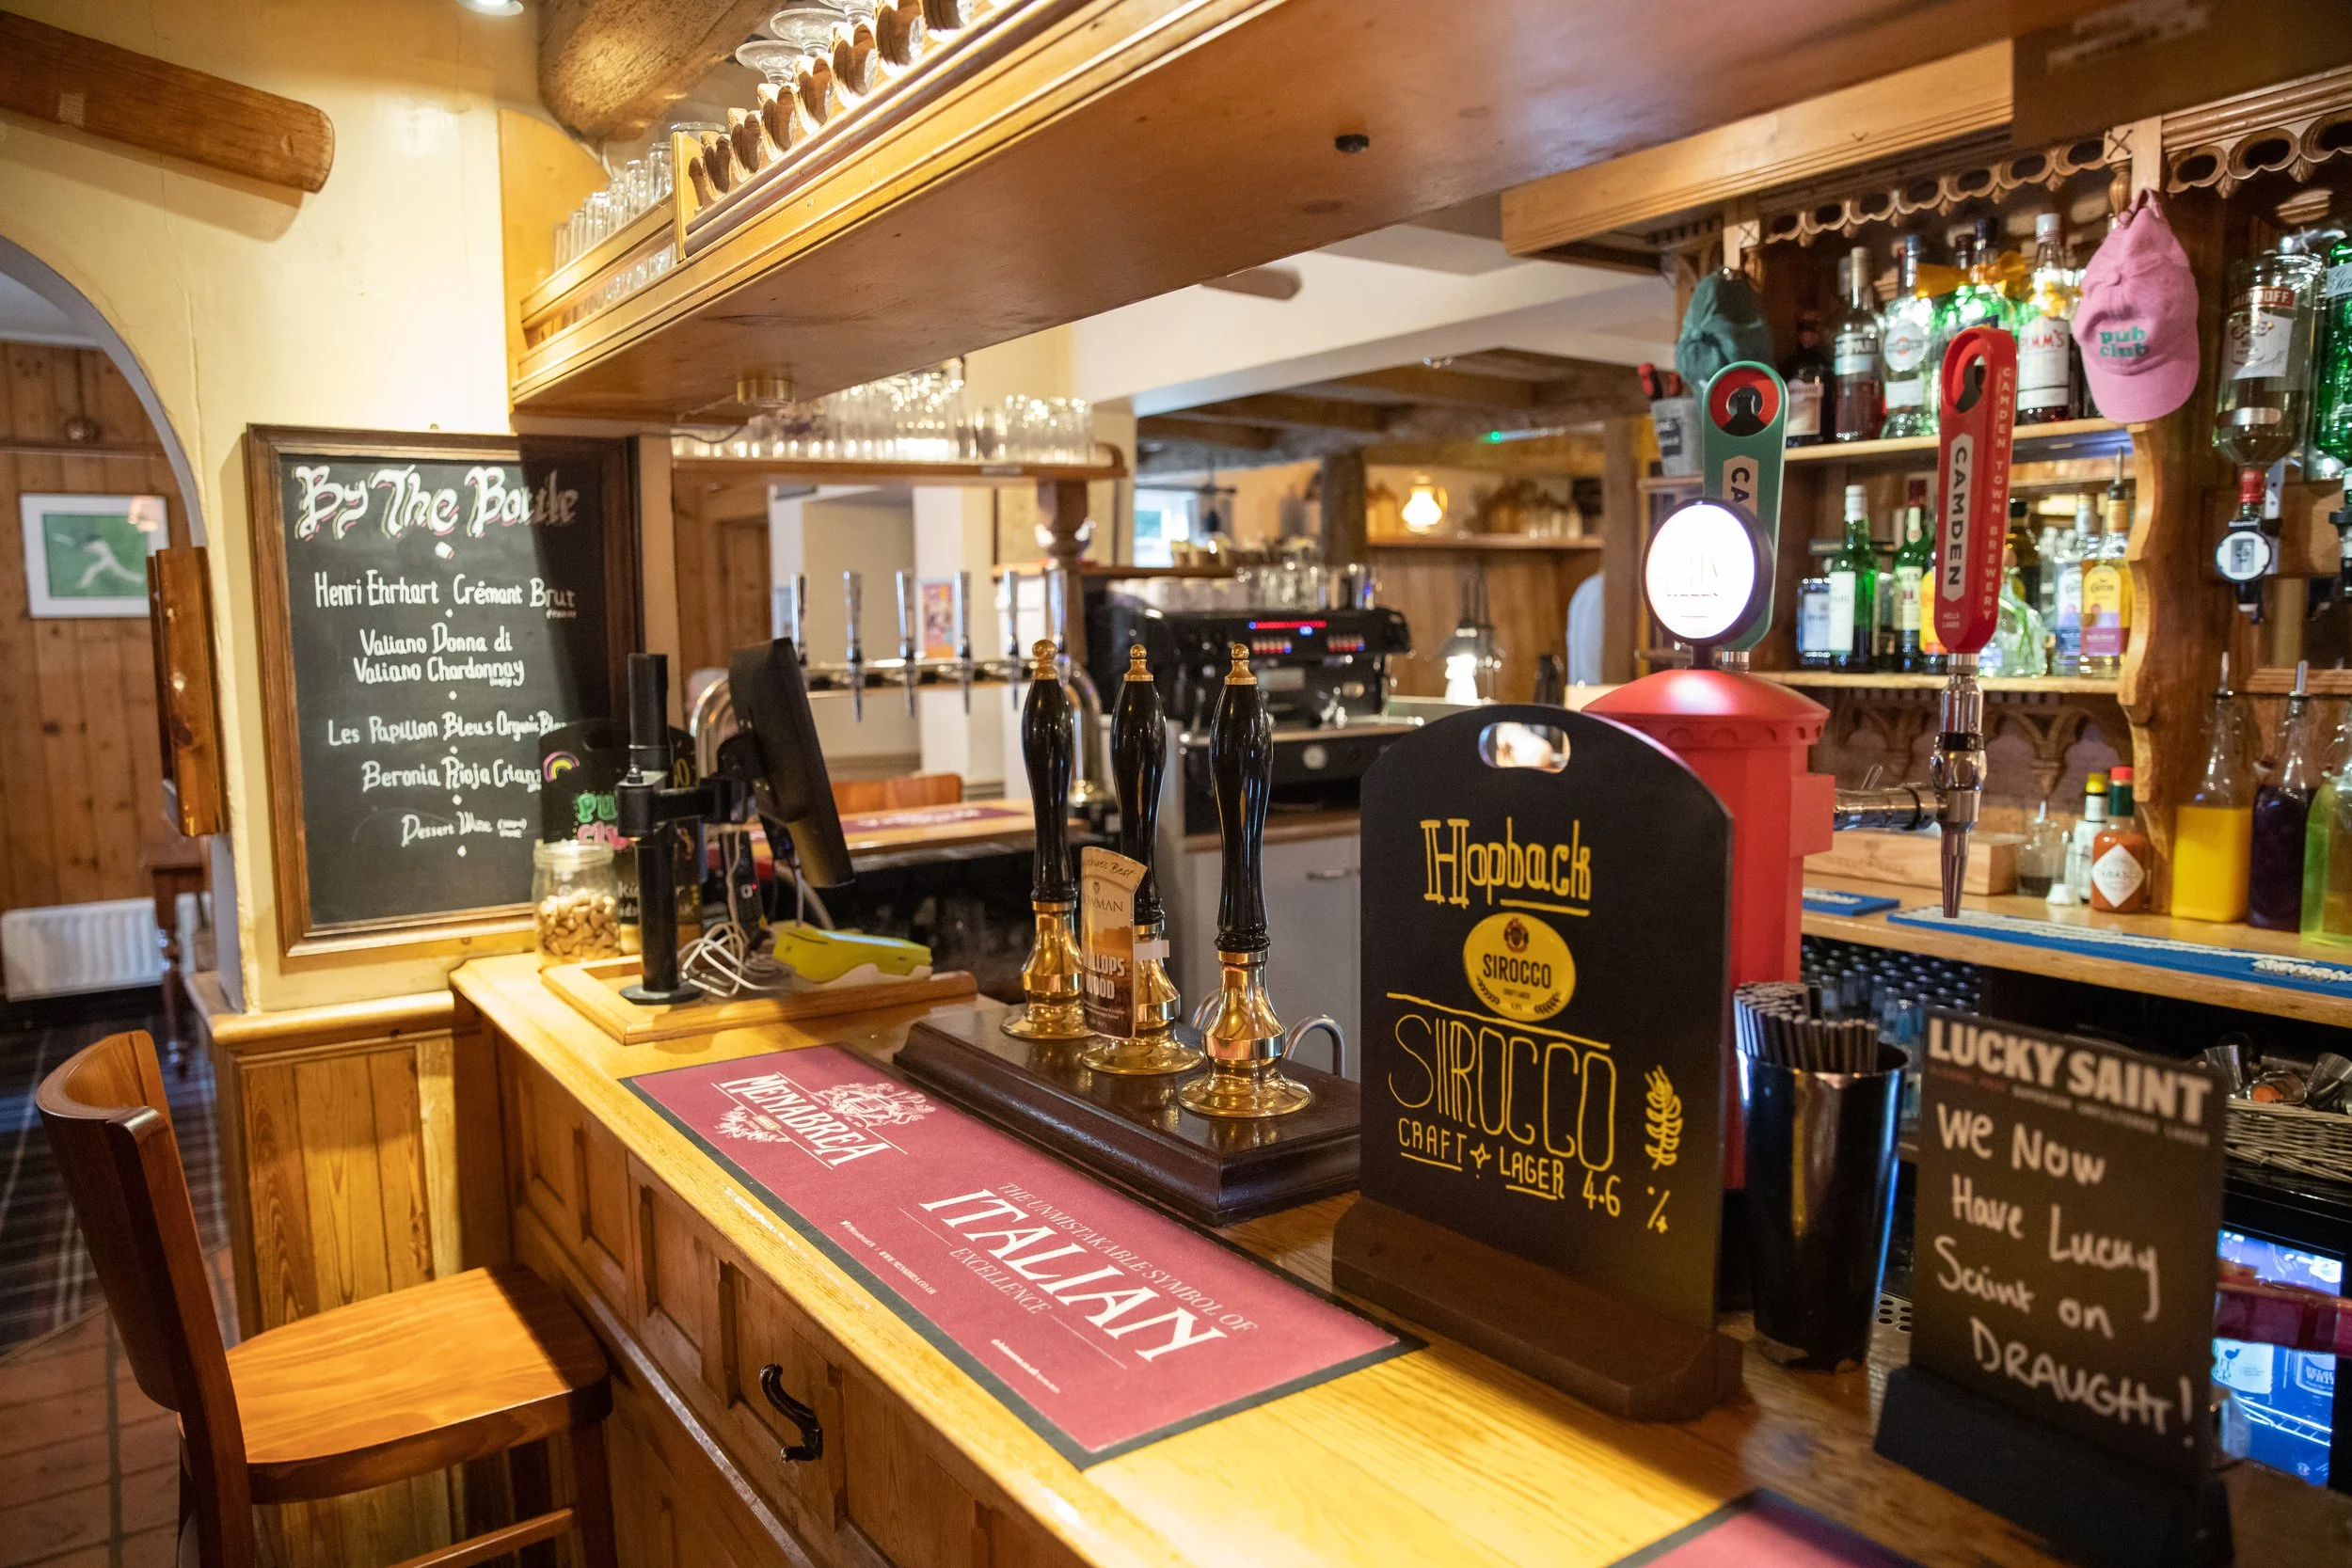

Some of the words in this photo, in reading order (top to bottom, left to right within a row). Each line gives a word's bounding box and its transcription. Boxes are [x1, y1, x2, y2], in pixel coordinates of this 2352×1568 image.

[2100, 326, 2146, 344] pub
[2100, 343, 2149, 357] club
[1996, 367, 2011, 449] CAMDEN
[293, 466, 369, 541] By
[370, 465, 460, 539] The
[464, 466, 579, 539] Bottle
[1947, 446, 1967, 586] CAMDEN
[1990, 461, 2003, 515] TOWN
[315, 571, 362, 608] Henri
[366, 569, 440, 607] Ehrhart
[453, 573, 524, 605] Crémant
[530, 577, 577, 608] Brut
[1982, 525, 1999, 621] BREWERY
[353, 657, 421, 685] Valiano
[427, 657, 525, 688] Chardonnay
[359, 628, 427, 656] Valiano
[431, 622, 487, 654] Donna
[494, 626, 513, 652] di
[328, 719, 359, 746] Les
[369, 716, 438, 744] Papillon
[442, 711, 494, 741] Bleus
[361, 760, 442, 793] Beronia
[440, 756, 490, 790] Rioja
[402, 814, 455, 847] Dessert
[1421, 817, 1591, 909] Hopback
[1086, 973, 1116, 1000] WOOD
[1483, 953, 1551, 990] SIROCCO
[1929, 1018, 2066, 1087] LUCKY
[2067, 1050, 2213, 1126] SAINT
[720, 1073, 892, 1166] MENABREA
[1936, 1102, 1994, 1160] We
[2010, 1123, 2106, 1185] Now
[1398, 1117, 1469, 1164] CRAFT
[1499, 1145, 1565, 1200] LAGER
[917, 1188, 1228, 1363] ITALIAN
[949, 1246, 1054, 1316] EXCELLENCE
[998, 1182, 1032, 1202] THE
[1028, 1197, 1154, 1272] UNMISTAKABLE
[1142, 1261, 1223, 1317] SYMBOL
[1219, 1312, 1259, 1333] OF
[1951, 1173, 2025, 1241] Have
[2048, 1204, 2160, 1322] Lucky
[1933, 1235, 2036, 1313] Saint
[2058, 1298, 2115, 1339] on
